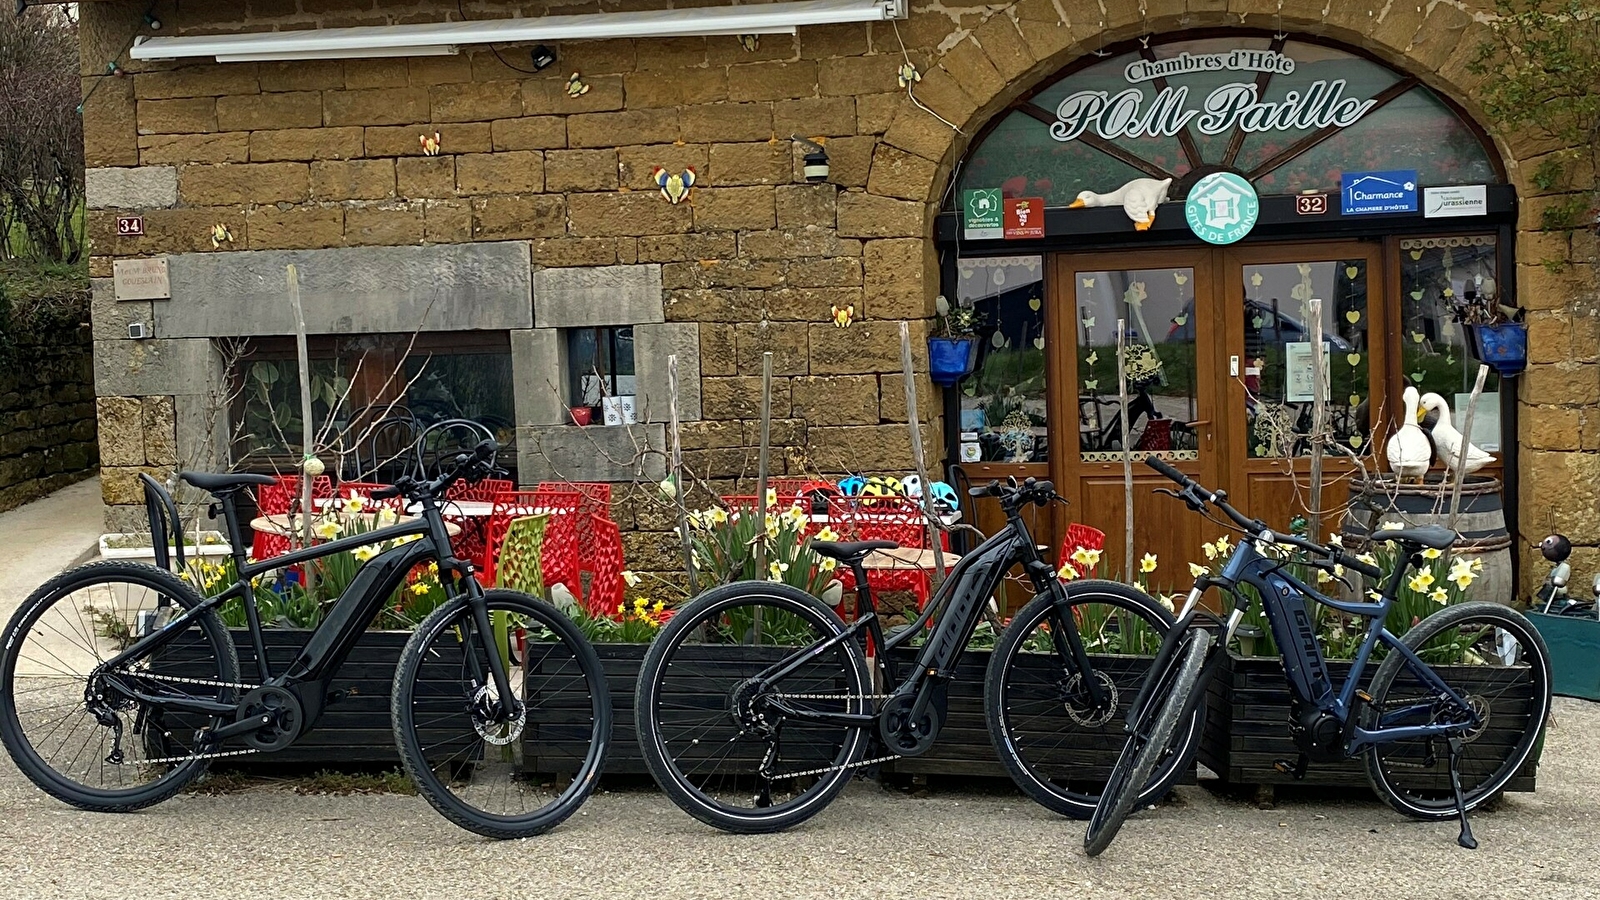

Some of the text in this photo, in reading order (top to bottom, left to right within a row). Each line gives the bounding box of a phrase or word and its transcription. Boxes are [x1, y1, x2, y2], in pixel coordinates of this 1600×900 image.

[1127, 54, 1222, 80] Chambres
[1051, 80, 1376, 140] POM Paille
[1300, 197, 1322, 212] 32
[1354, 190, 1404, 201] Charmance
[120, 219, 139, 232] 34
[1208, 231, 1224, 242] DE
[1227, 200, 1256, 240] FRANCE
[1293, 609, 1328, 684] GIANT
